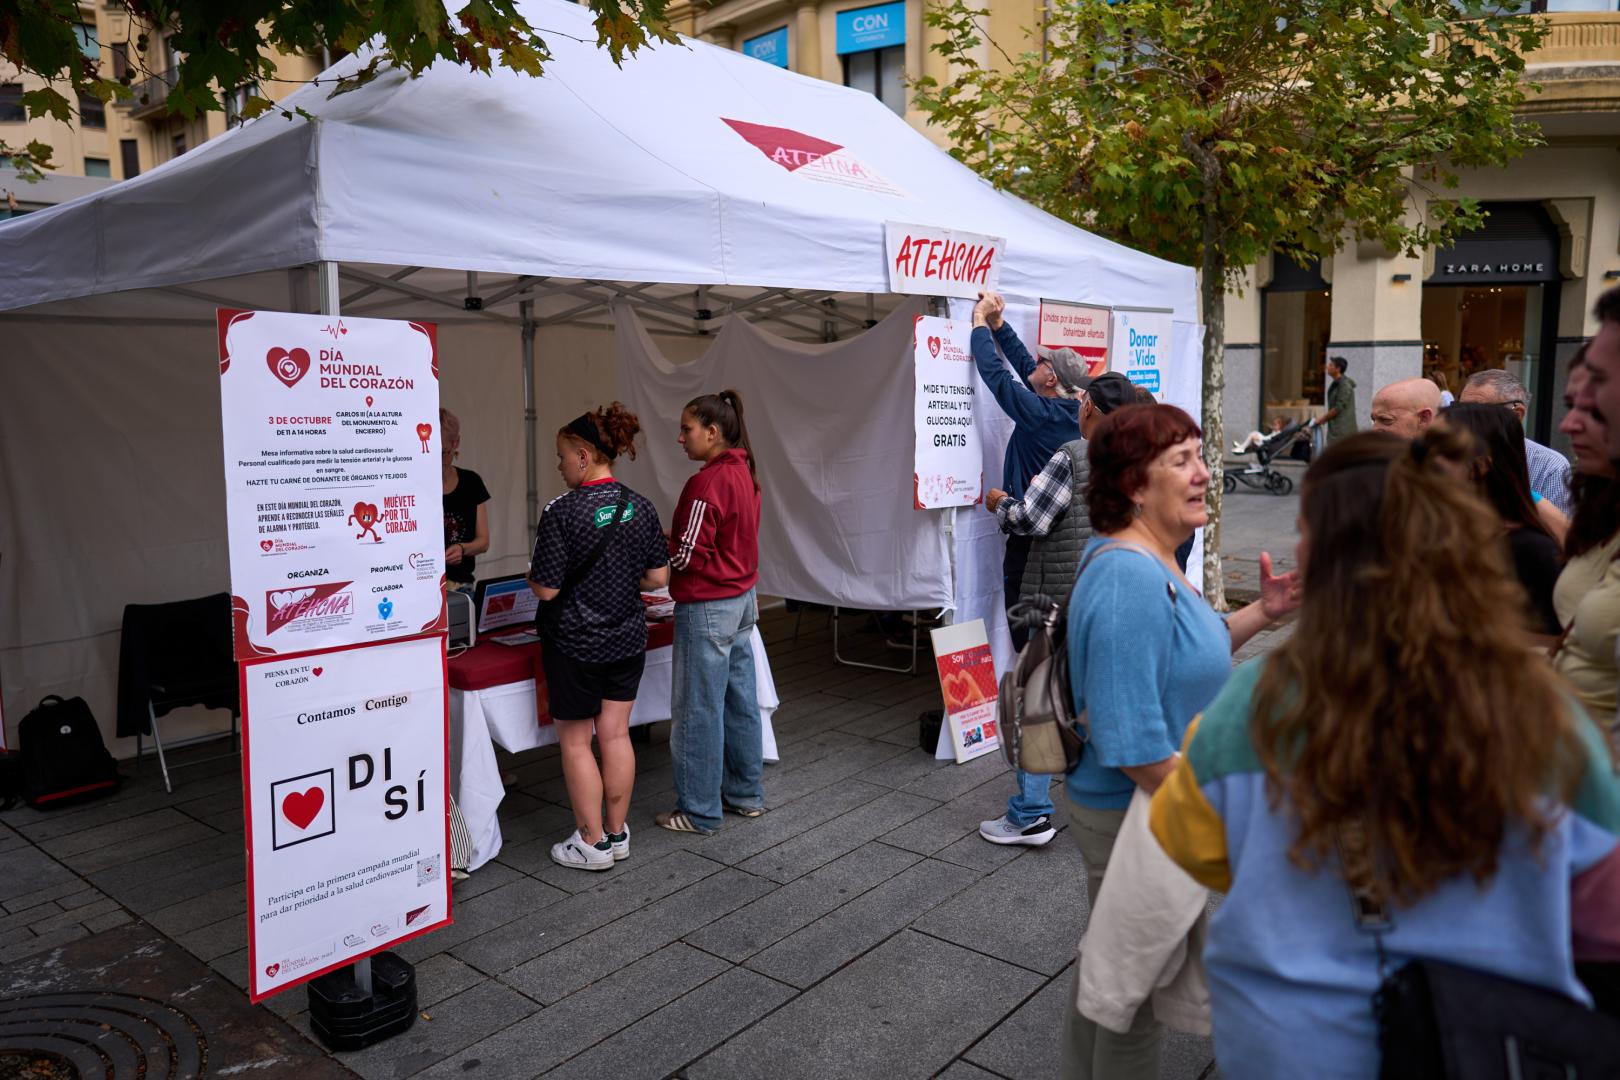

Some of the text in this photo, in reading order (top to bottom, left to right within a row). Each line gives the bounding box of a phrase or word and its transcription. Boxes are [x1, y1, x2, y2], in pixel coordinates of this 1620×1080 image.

[853, 13, 888, 31] CON
[896, 235, 994, 284] ATEHCNA
[1447, 263, 1543, 272] ZARA HOME
[1130, 328, 1158, 347] Donar
[319, 348, 344, 362] DÍA
[1136, 349, 1155, 366] Vida
[319, 364, 382, 376] MUNDIAL
[320, 376, 414, 390] DEL CORAZÓN
[924, 384, 975, 395] MIDE TU TENSIÓN
[928, 401, 971, 410] ARTERIAL Y TU
[927, 415, 972, 426] GLUCOSA AQUÍ
[934, 434, 966, 447] GRATIS
[265, 503, 277, 511] ESTE
[278, 501, 286, 510] DÍA
[288, 500, 309, 510] MUNDIAL
[384, 494, 415, 509] MUÉVETE
[258, 513, 280, 522] APRENDE
[286, 511, 313, 521] RECONOCER
[324, 509, 344, 518] SEÑALES
[384, 509, 409, 521] POR TU
[259, 525, 265, 533] DE
[266, 524, 287, 533] ALARMA
[293, 521, 320, 531] PROTÉGELO.
[386, 519, 417, 533] CORAZÓN
[287, 568, 329, 579] ORGANIZA
[371, 564, 403, 574] PROMUEVE
[372, 584, 403, 593] COLABORA
[264, 670, 289, 678] PIENSA
[275, 676, 309, 688] CORAZÓN
[297, 695, 408, 725] Contamos Contigo
[268, 888, 304, 905] Participa
[305, 884, 316, 894] en
[326, 871, 356, 888] primera
[358, 860, 390, 878] campaña
[392, 849, 420, 866] mundial
[260, 909, 278, 922] para
[280, 904, 292, 914] dar
[294, 891, 329, 911] prioridad
[336, 886, 344, 895] la
[345, 879, 364, 892] salud
[365, 864, 413, 885] cardiovascular
